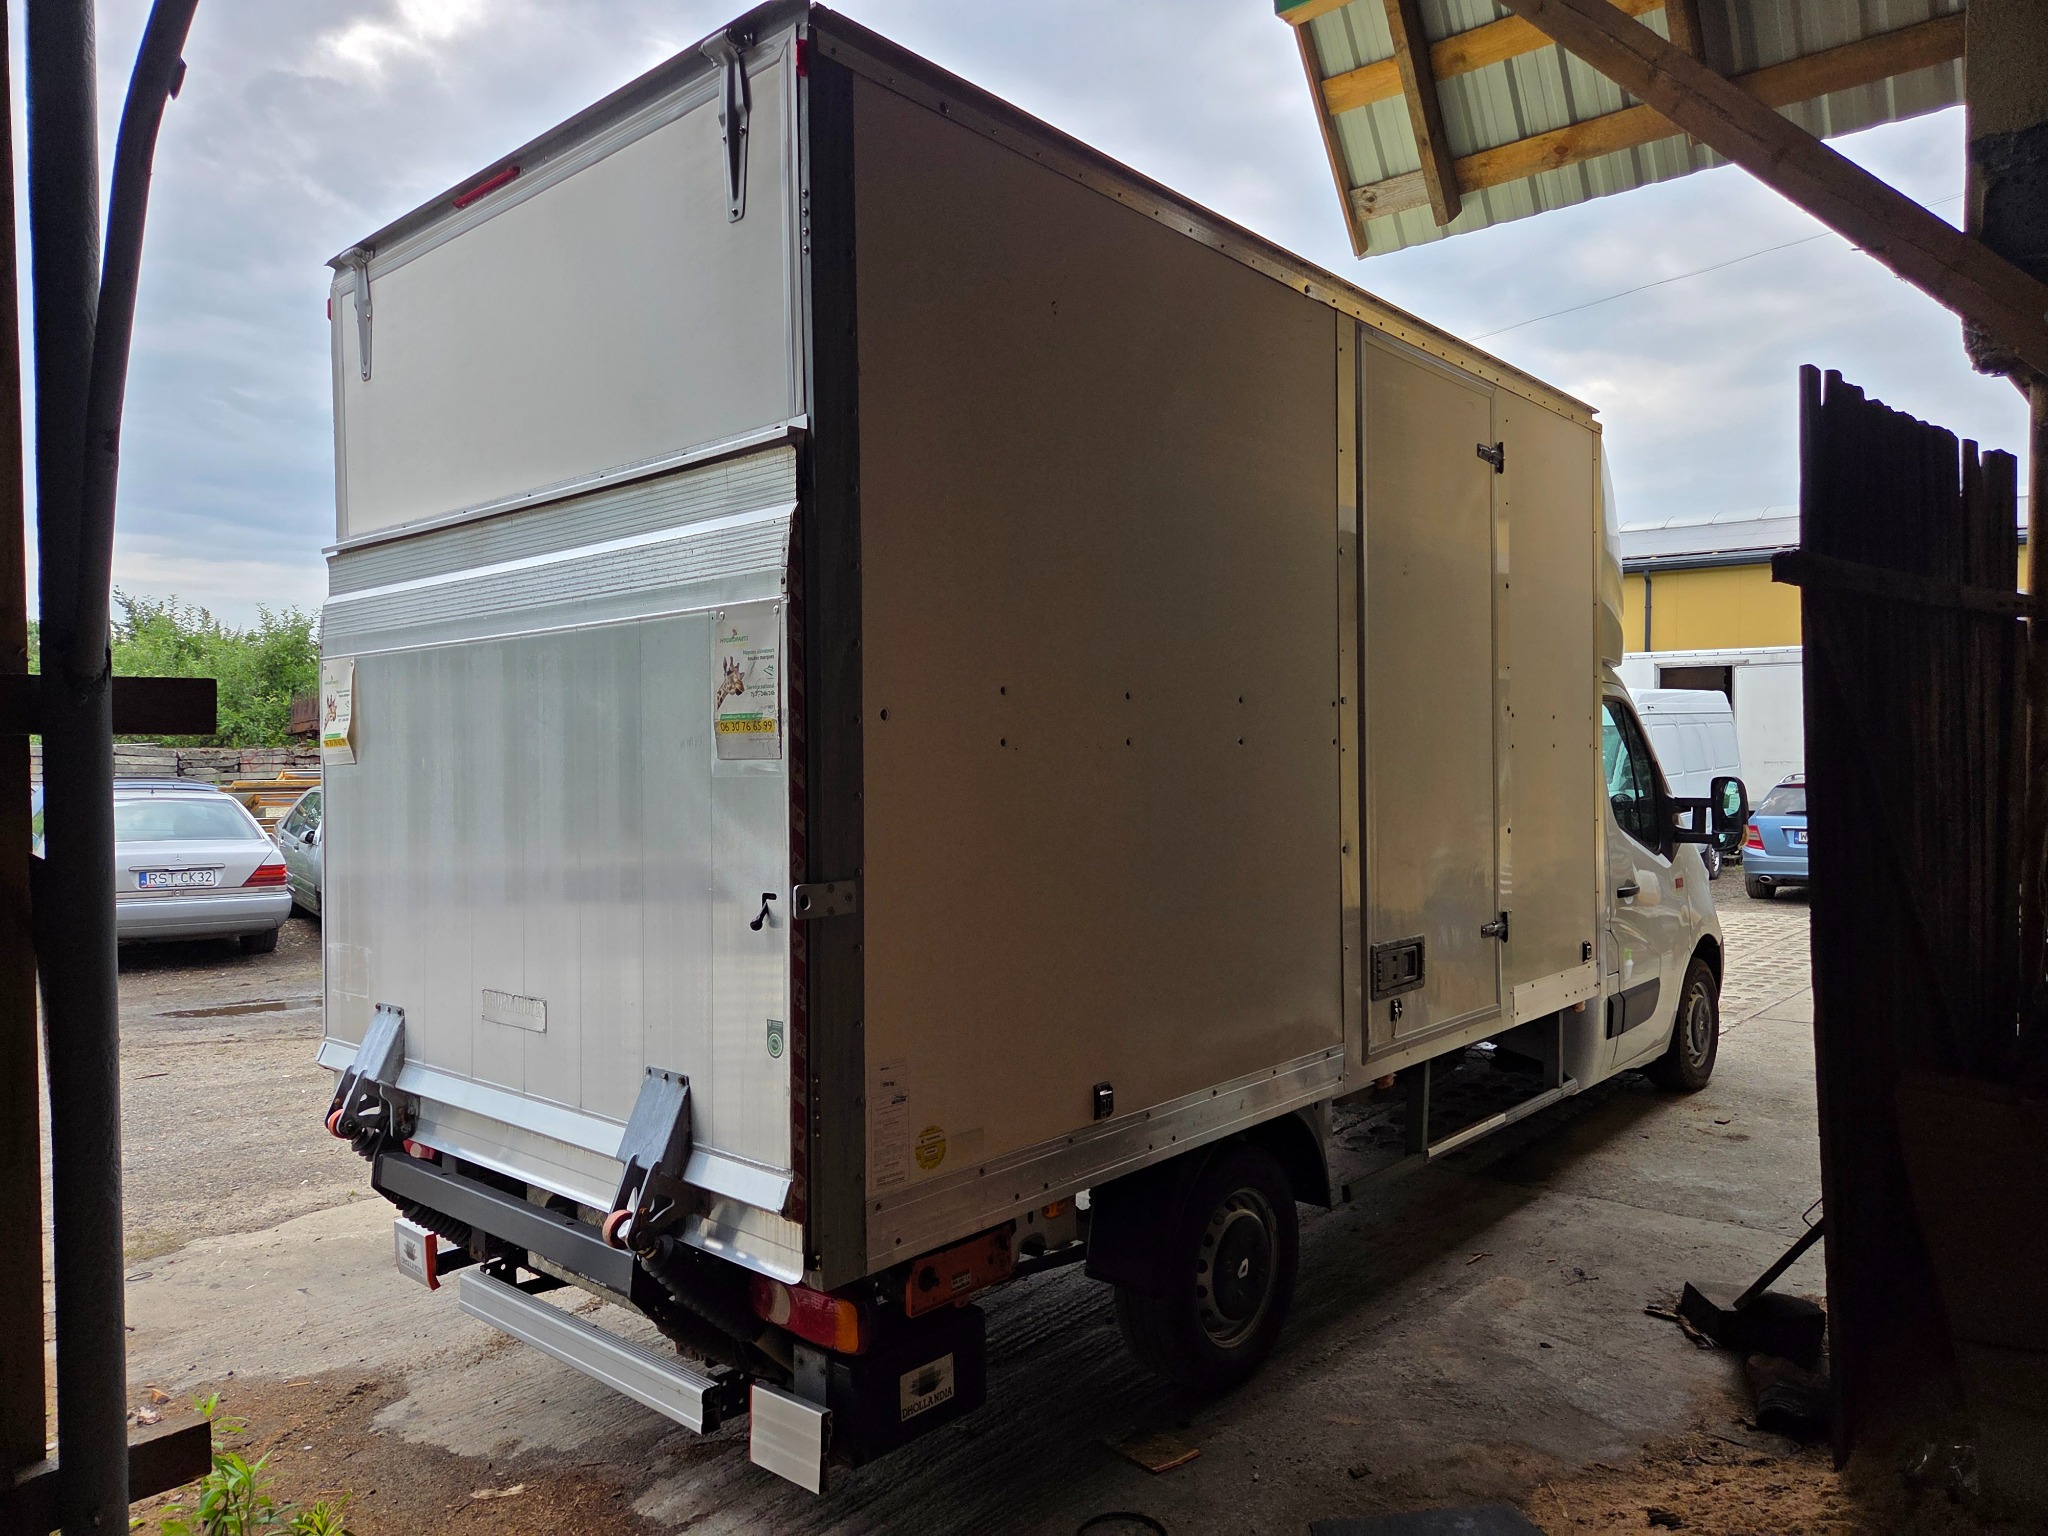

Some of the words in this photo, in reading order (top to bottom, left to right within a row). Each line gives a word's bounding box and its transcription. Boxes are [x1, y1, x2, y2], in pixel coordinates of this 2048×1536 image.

[720, 722, 730, 732] 06
[731, 721, 740, 732] 30
[742, 721, 751, 731] 76
[752, 720, 762, 731] 65
[763, 720, 773, 731] 99
[148, 872, 176, 884] RST
[180, 871, 212, 883] CK32
[902, 1386, 953, 1419] DHOLLANDIA
